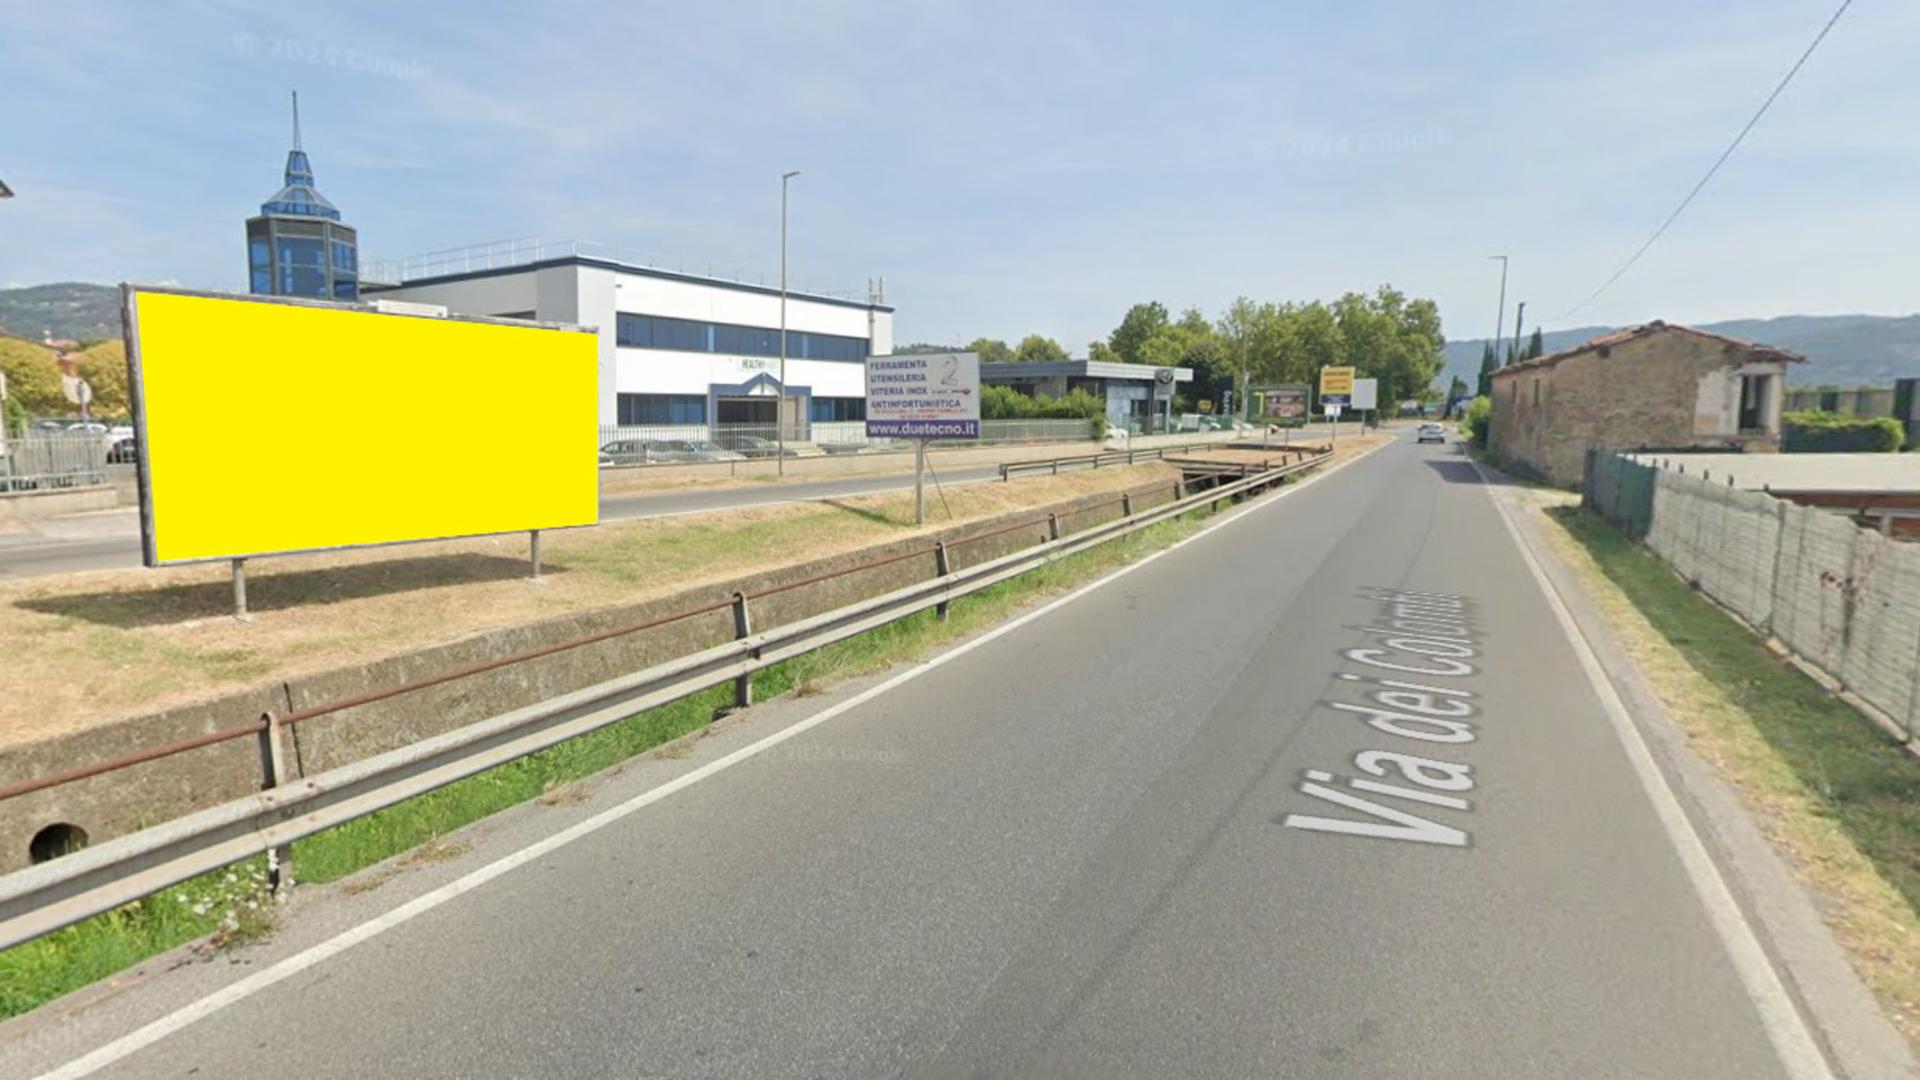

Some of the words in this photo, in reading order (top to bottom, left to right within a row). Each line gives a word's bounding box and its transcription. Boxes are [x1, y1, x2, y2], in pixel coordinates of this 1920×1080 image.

[870, 360, 928, 371] FERRAMENTA
[870, 374, 927, 383] UTENSILERIA
[871, 387, 905, 396] VITERIA
[906, 387, 928, 395] INOX
[871, 399, 961, 409] ANTINFORTUNISTICA
[868, 422, 975, 435] www.duetecno.it
